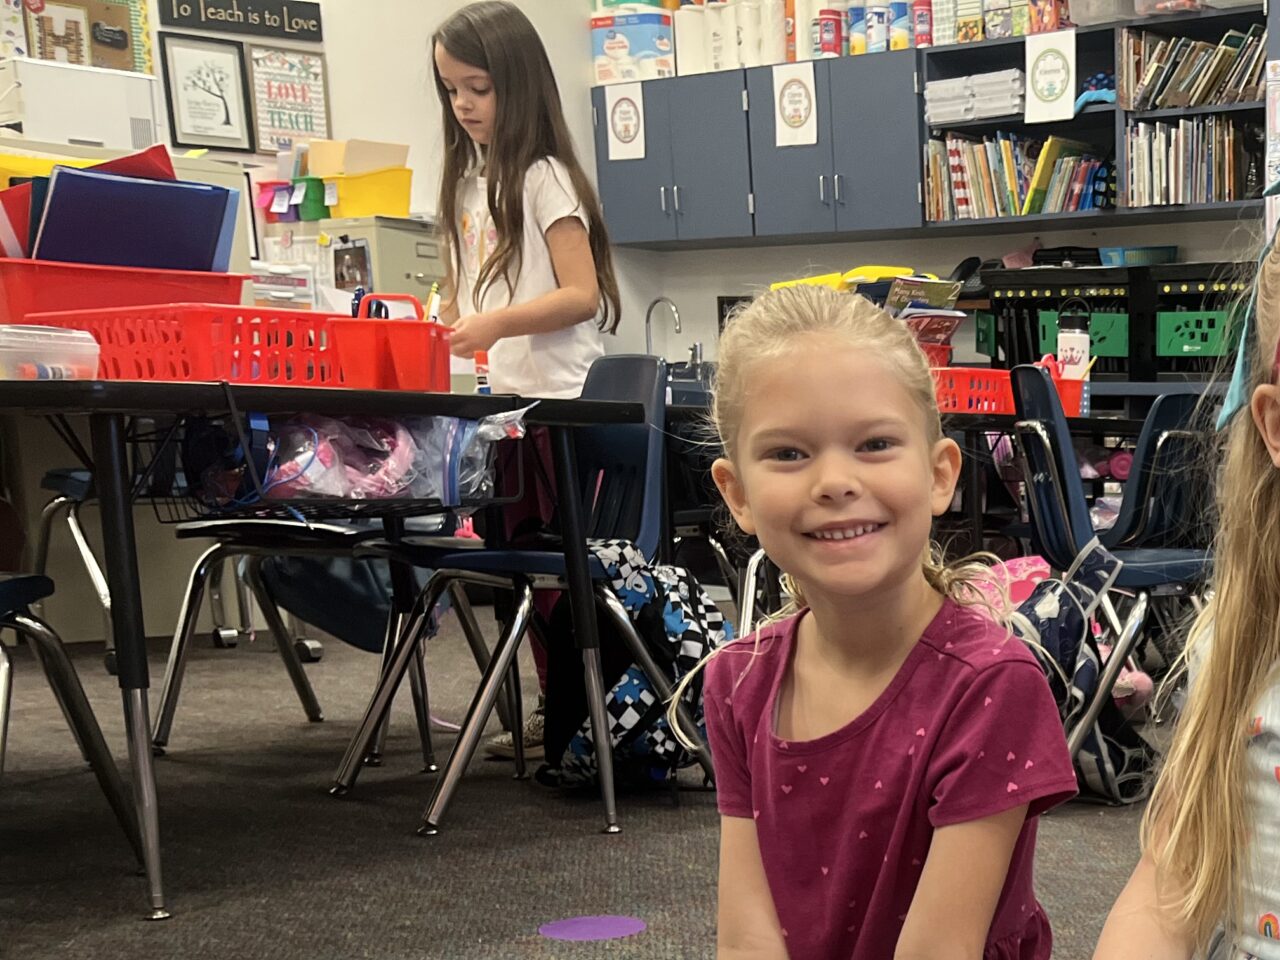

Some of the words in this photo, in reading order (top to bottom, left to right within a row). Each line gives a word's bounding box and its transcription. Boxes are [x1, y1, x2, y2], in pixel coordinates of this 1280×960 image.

[248, 6, 260, 25] is
[265, 10, 280, 27] to
[283, 6, 318, 33] Love
[265, 80, 311, 103] LOVE
[267, 109, 315, 133] TEACH
[946, 281, 962, 300] 2
